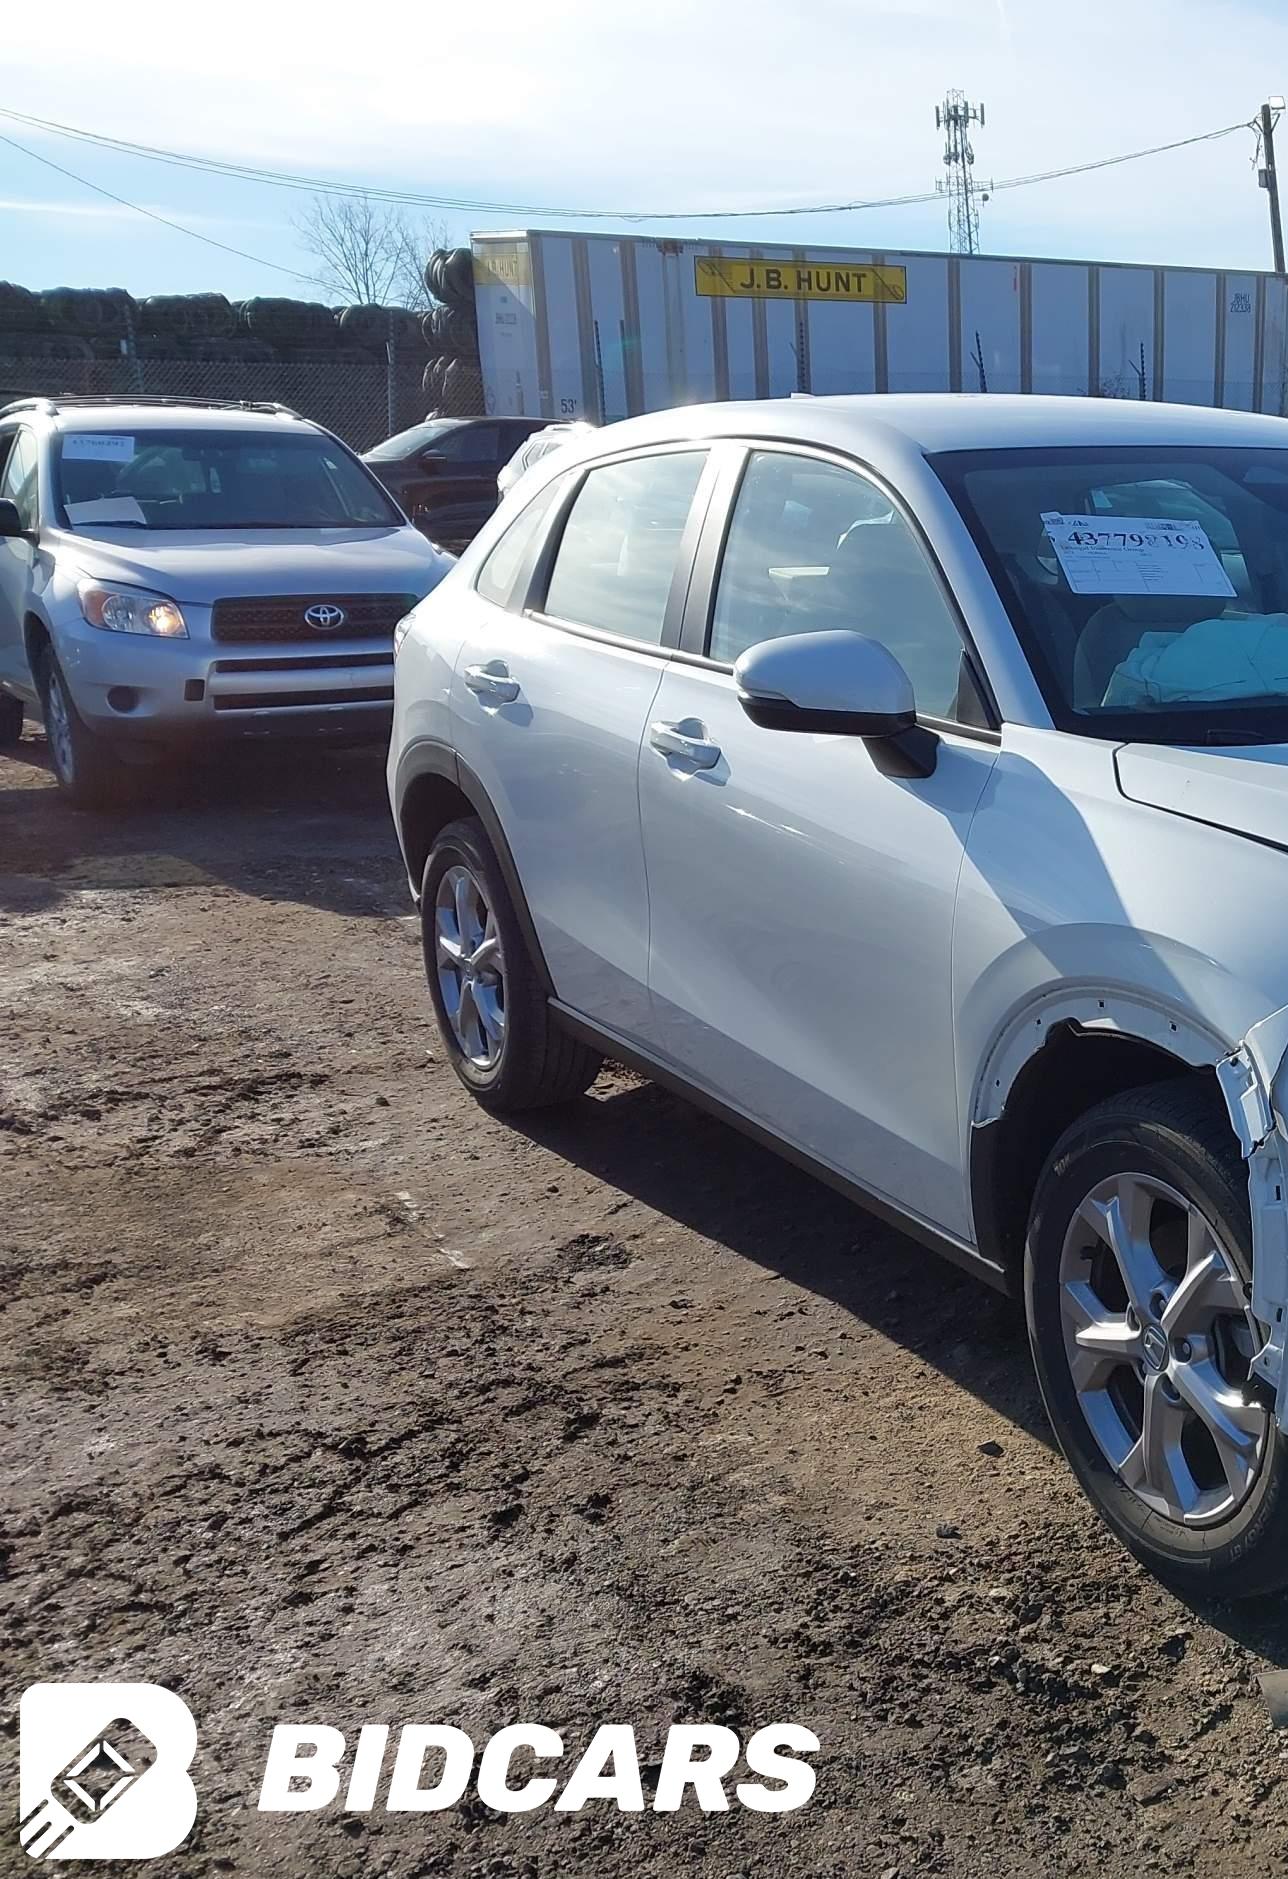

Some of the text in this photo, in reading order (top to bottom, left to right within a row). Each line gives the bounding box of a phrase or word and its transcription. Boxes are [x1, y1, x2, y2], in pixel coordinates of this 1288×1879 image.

[740, 267, 868, 293] J.B. HUNT
[560, 398, 577, 413] 53'
